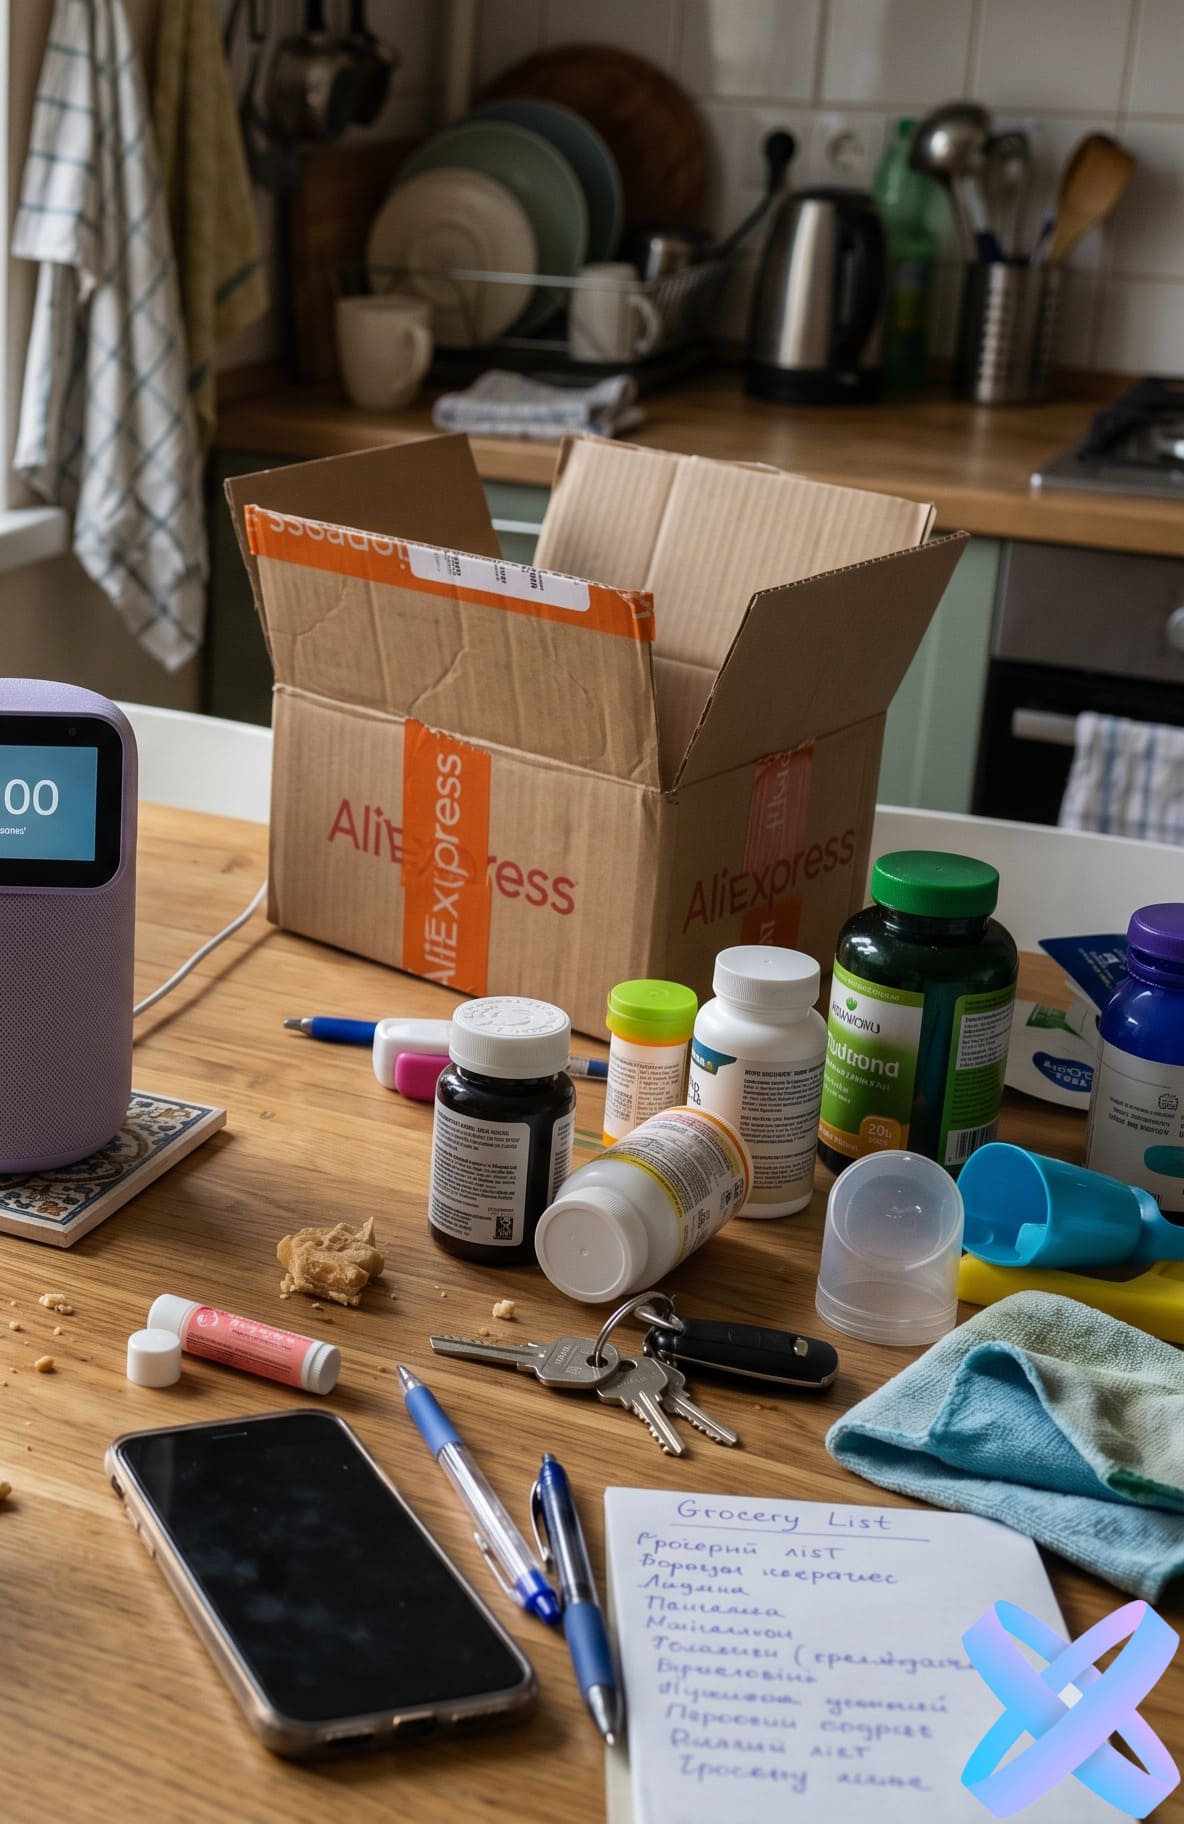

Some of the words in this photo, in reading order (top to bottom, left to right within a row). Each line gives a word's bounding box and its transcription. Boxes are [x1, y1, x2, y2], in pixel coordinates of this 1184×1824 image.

[682, 828, 856, 935] AliExpress
[677, 1499, 800, 1532] Grocery
[828, 1511, 892, 1530] List
